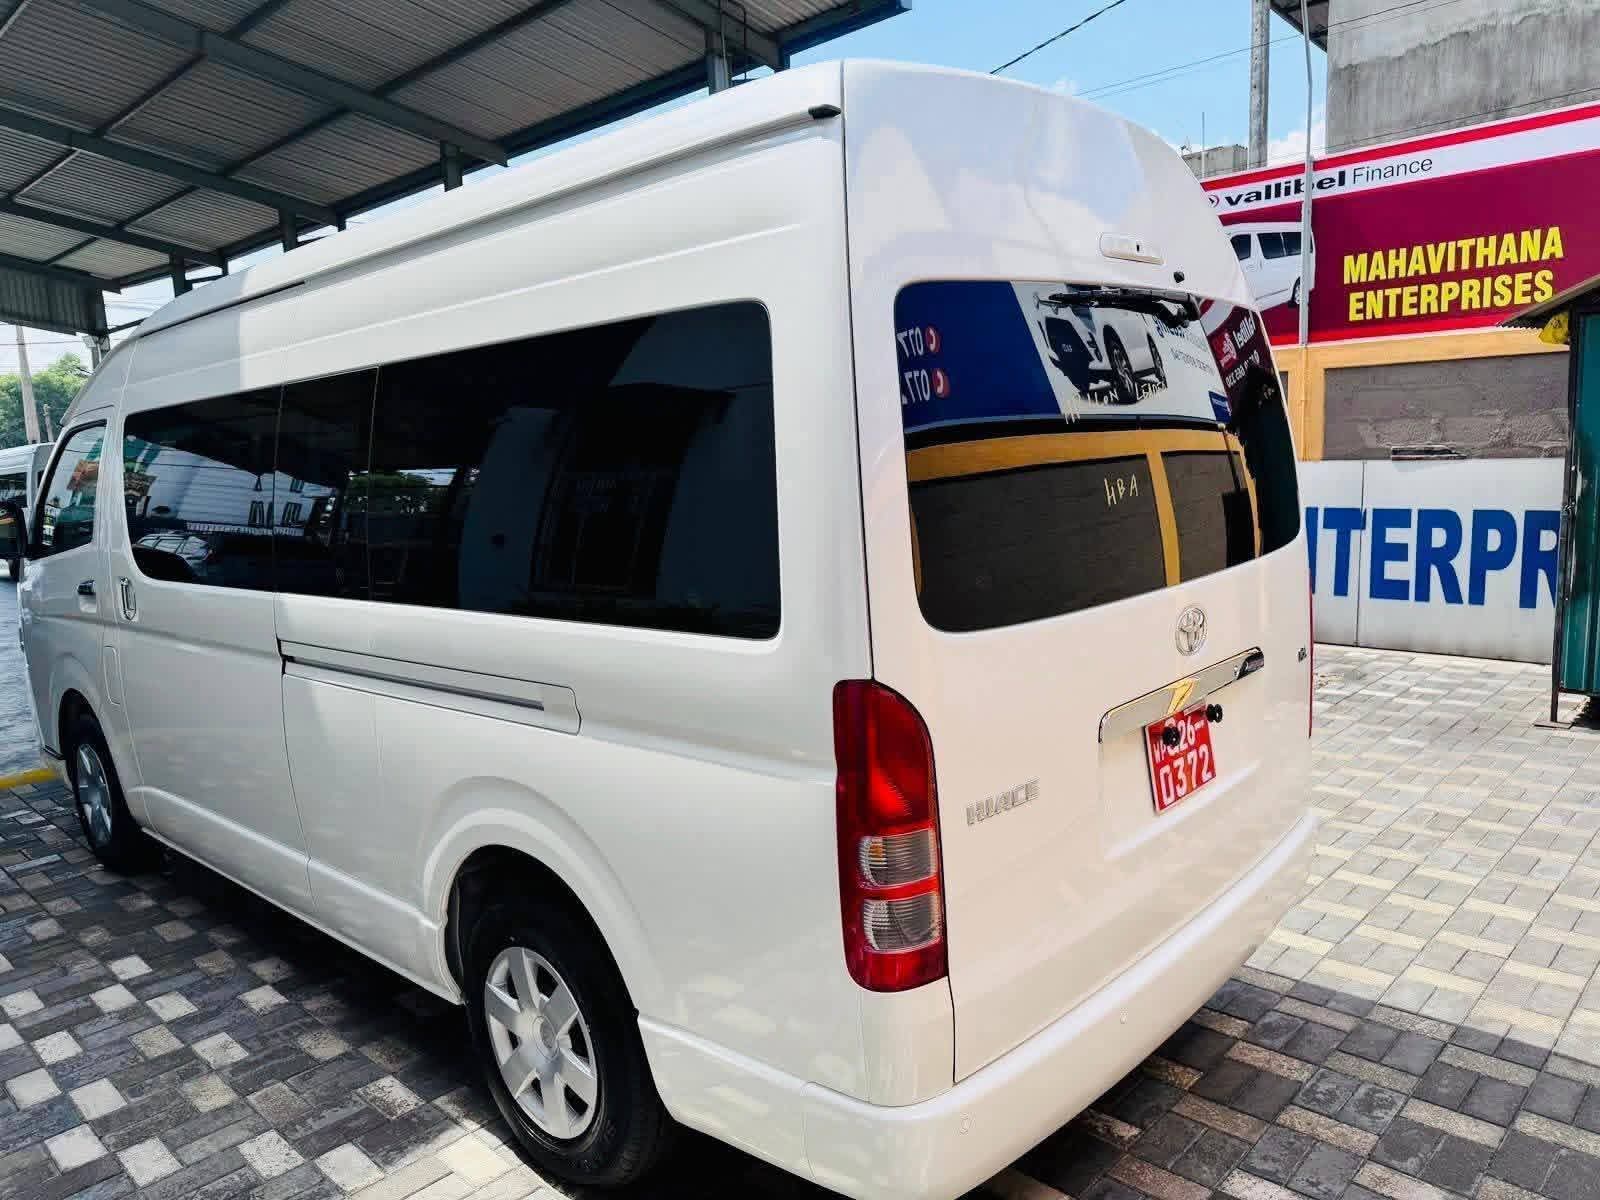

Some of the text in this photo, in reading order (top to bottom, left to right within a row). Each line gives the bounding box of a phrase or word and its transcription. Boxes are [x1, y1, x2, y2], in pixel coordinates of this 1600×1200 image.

[1352, 157, 1433, 184] Finance
[1343, 226, 1564, 285] MAHAVITHANA
[1348, 269, 1554, 322] ENTERPRISES
[1160, 743, 1213, 806] 0372
